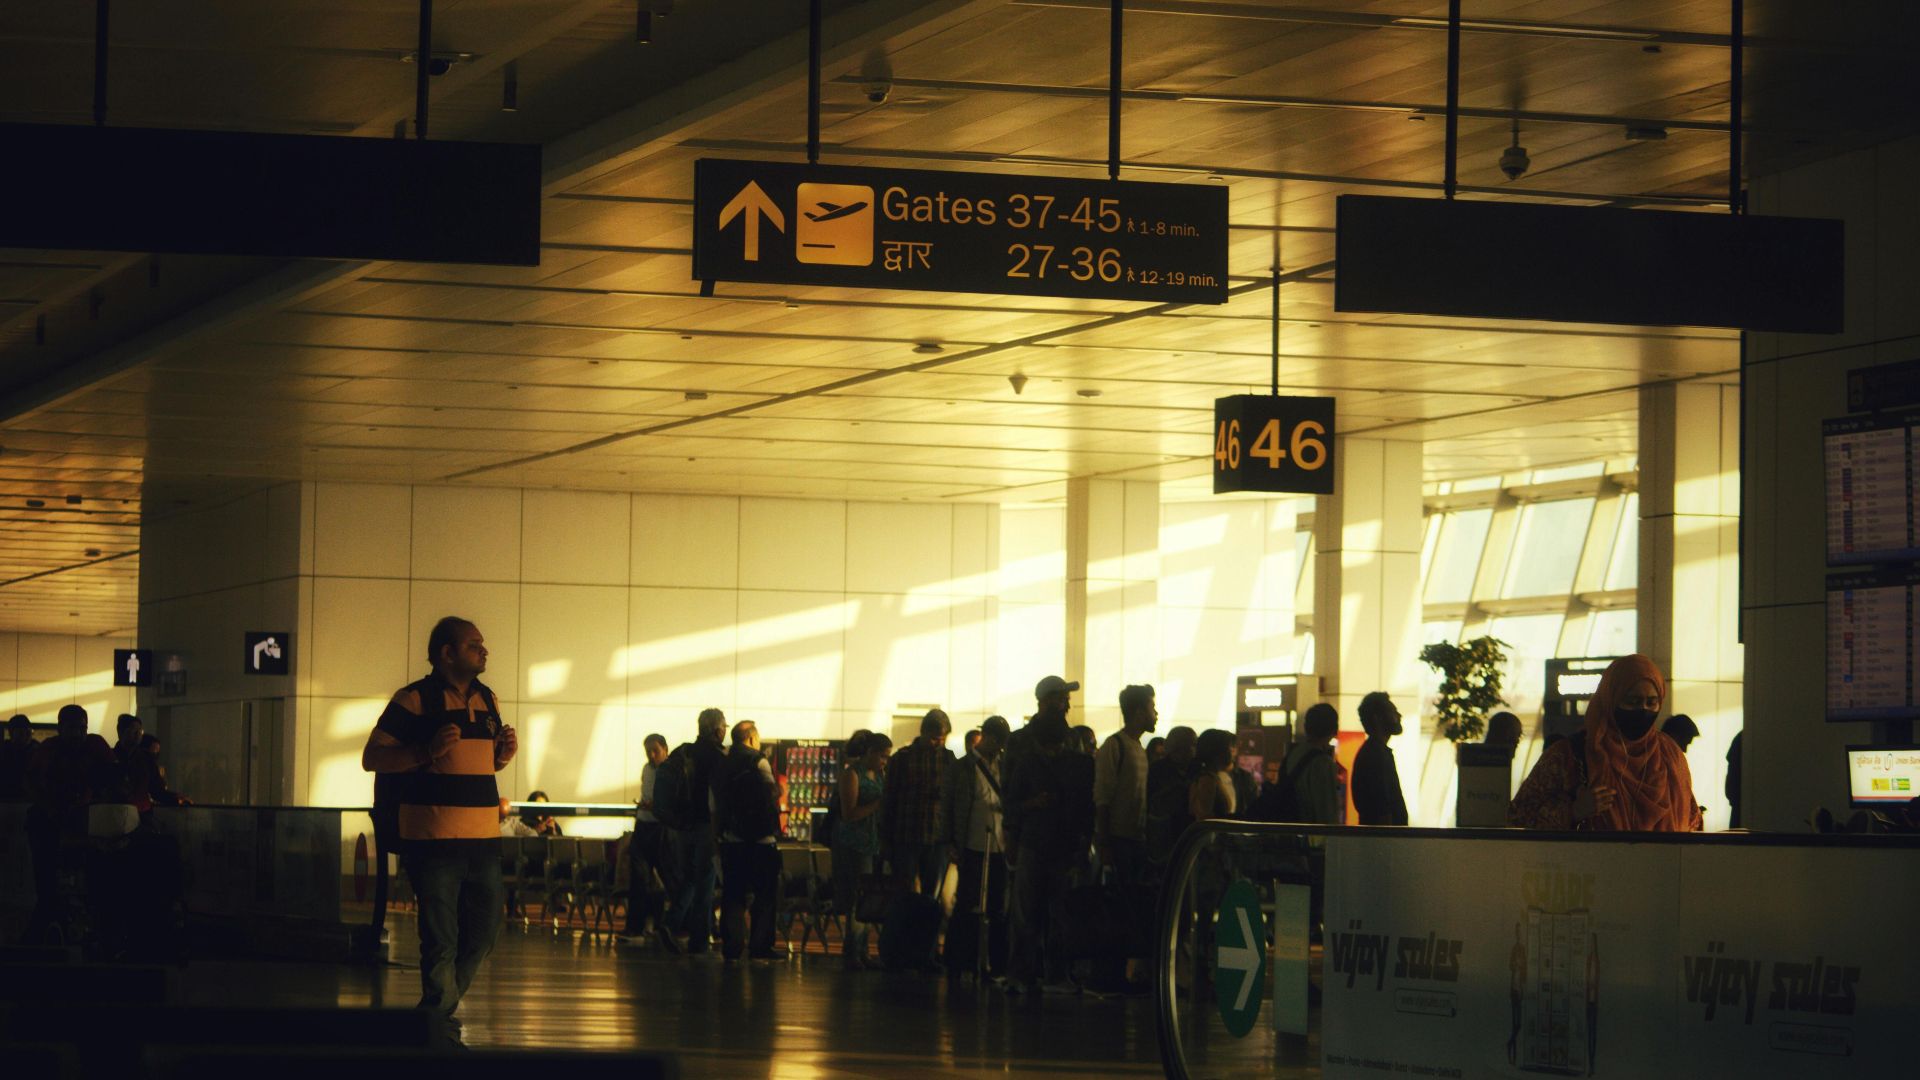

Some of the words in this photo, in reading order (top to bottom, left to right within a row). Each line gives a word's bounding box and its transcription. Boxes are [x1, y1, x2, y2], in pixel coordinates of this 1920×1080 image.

[882, 186, 996, 225] Gates
[1007, 194, 1121, 233] 37-45
[1139, 221, 1166, 235] 1-8
[1170, 222, 1200, 237] min.
[882, 240, 934, 273] द्वार
[1007, 243, 1122, 282] 27-36
[1139, 270, 1185, 286] 12-19
[1188, 272, 1219, 287] min.
[1215, 419, 1240, 470] 46
[1249, 418, 1327, 471] 46
